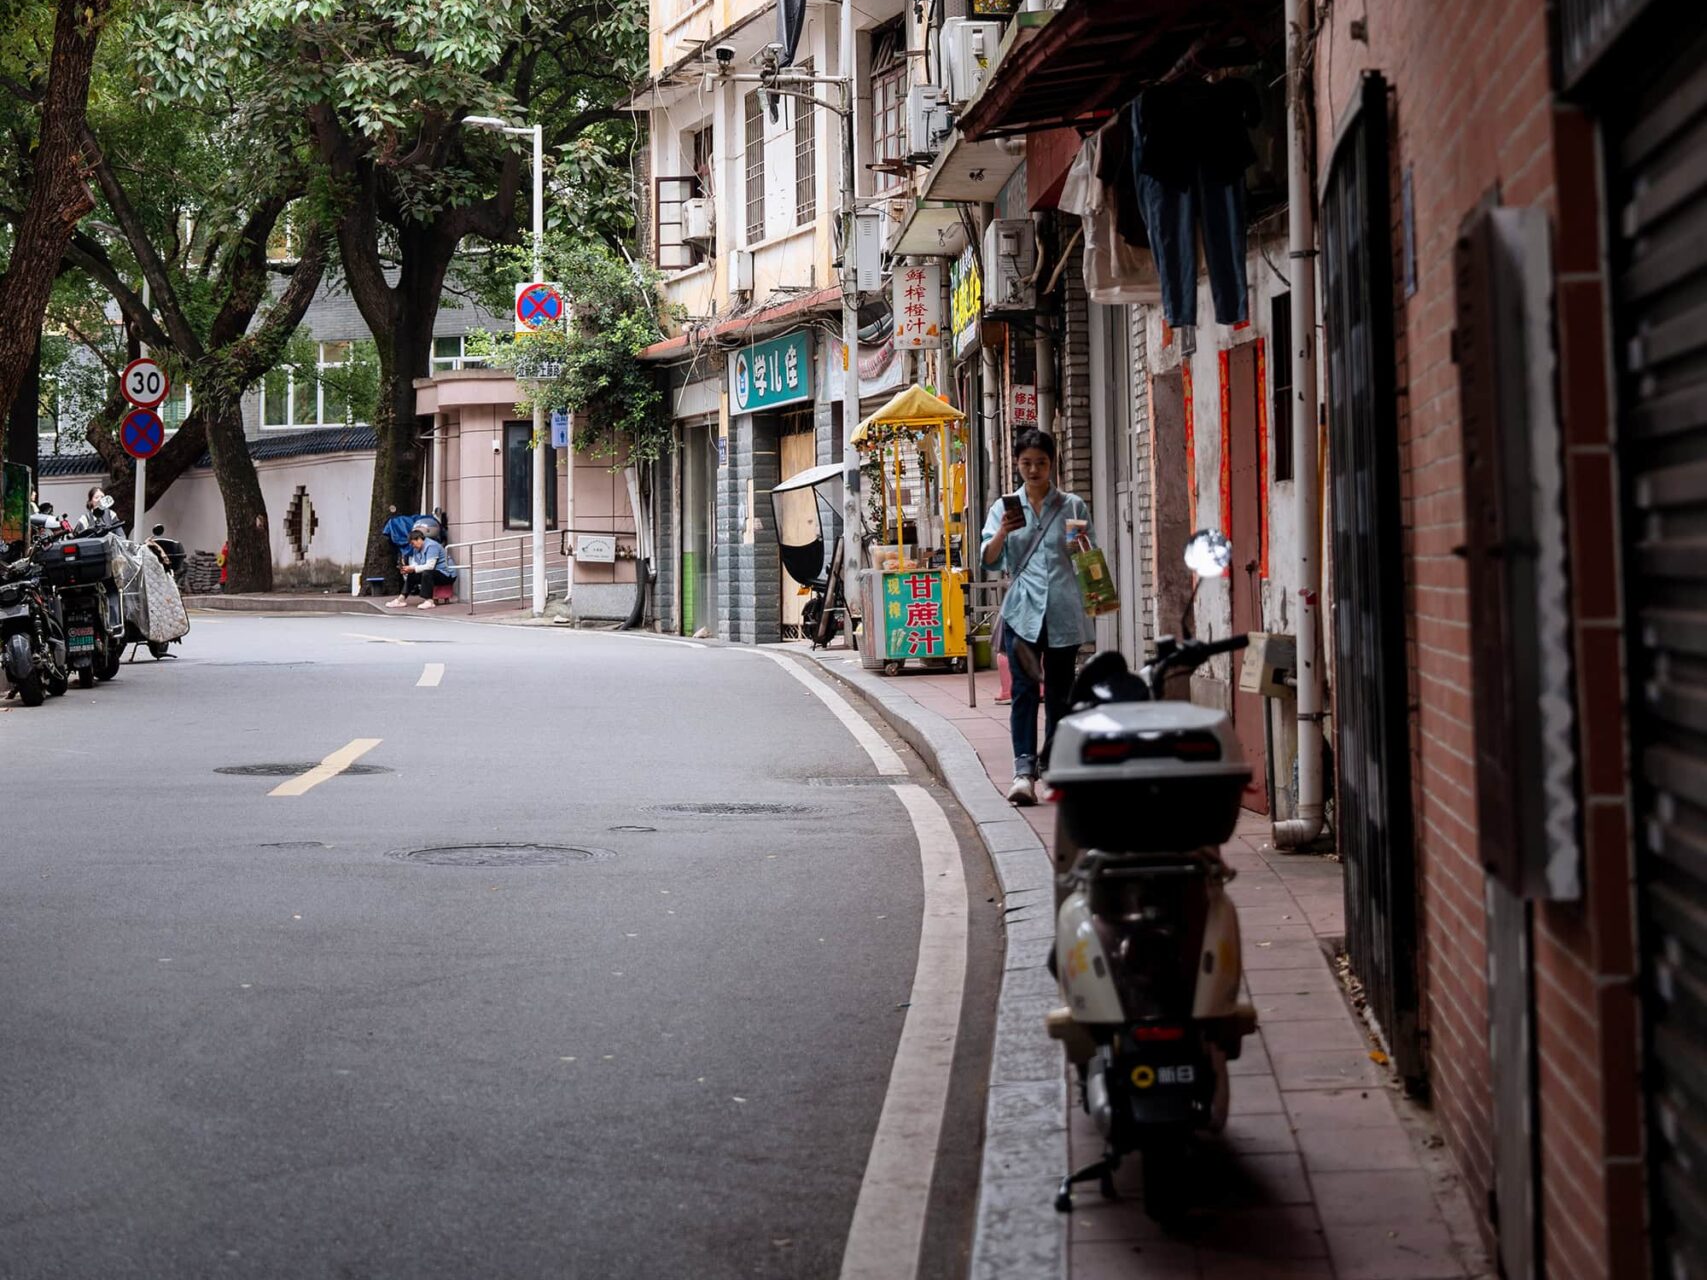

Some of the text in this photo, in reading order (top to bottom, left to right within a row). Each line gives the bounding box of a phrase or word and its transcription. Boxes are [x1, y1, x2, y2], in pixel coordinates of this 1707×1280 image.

[904, 268, 928, 334] 鲜榨橙汁
[132, 371, 160, 394] 30
[903, 574, 941, 654] 甘蔗汁
